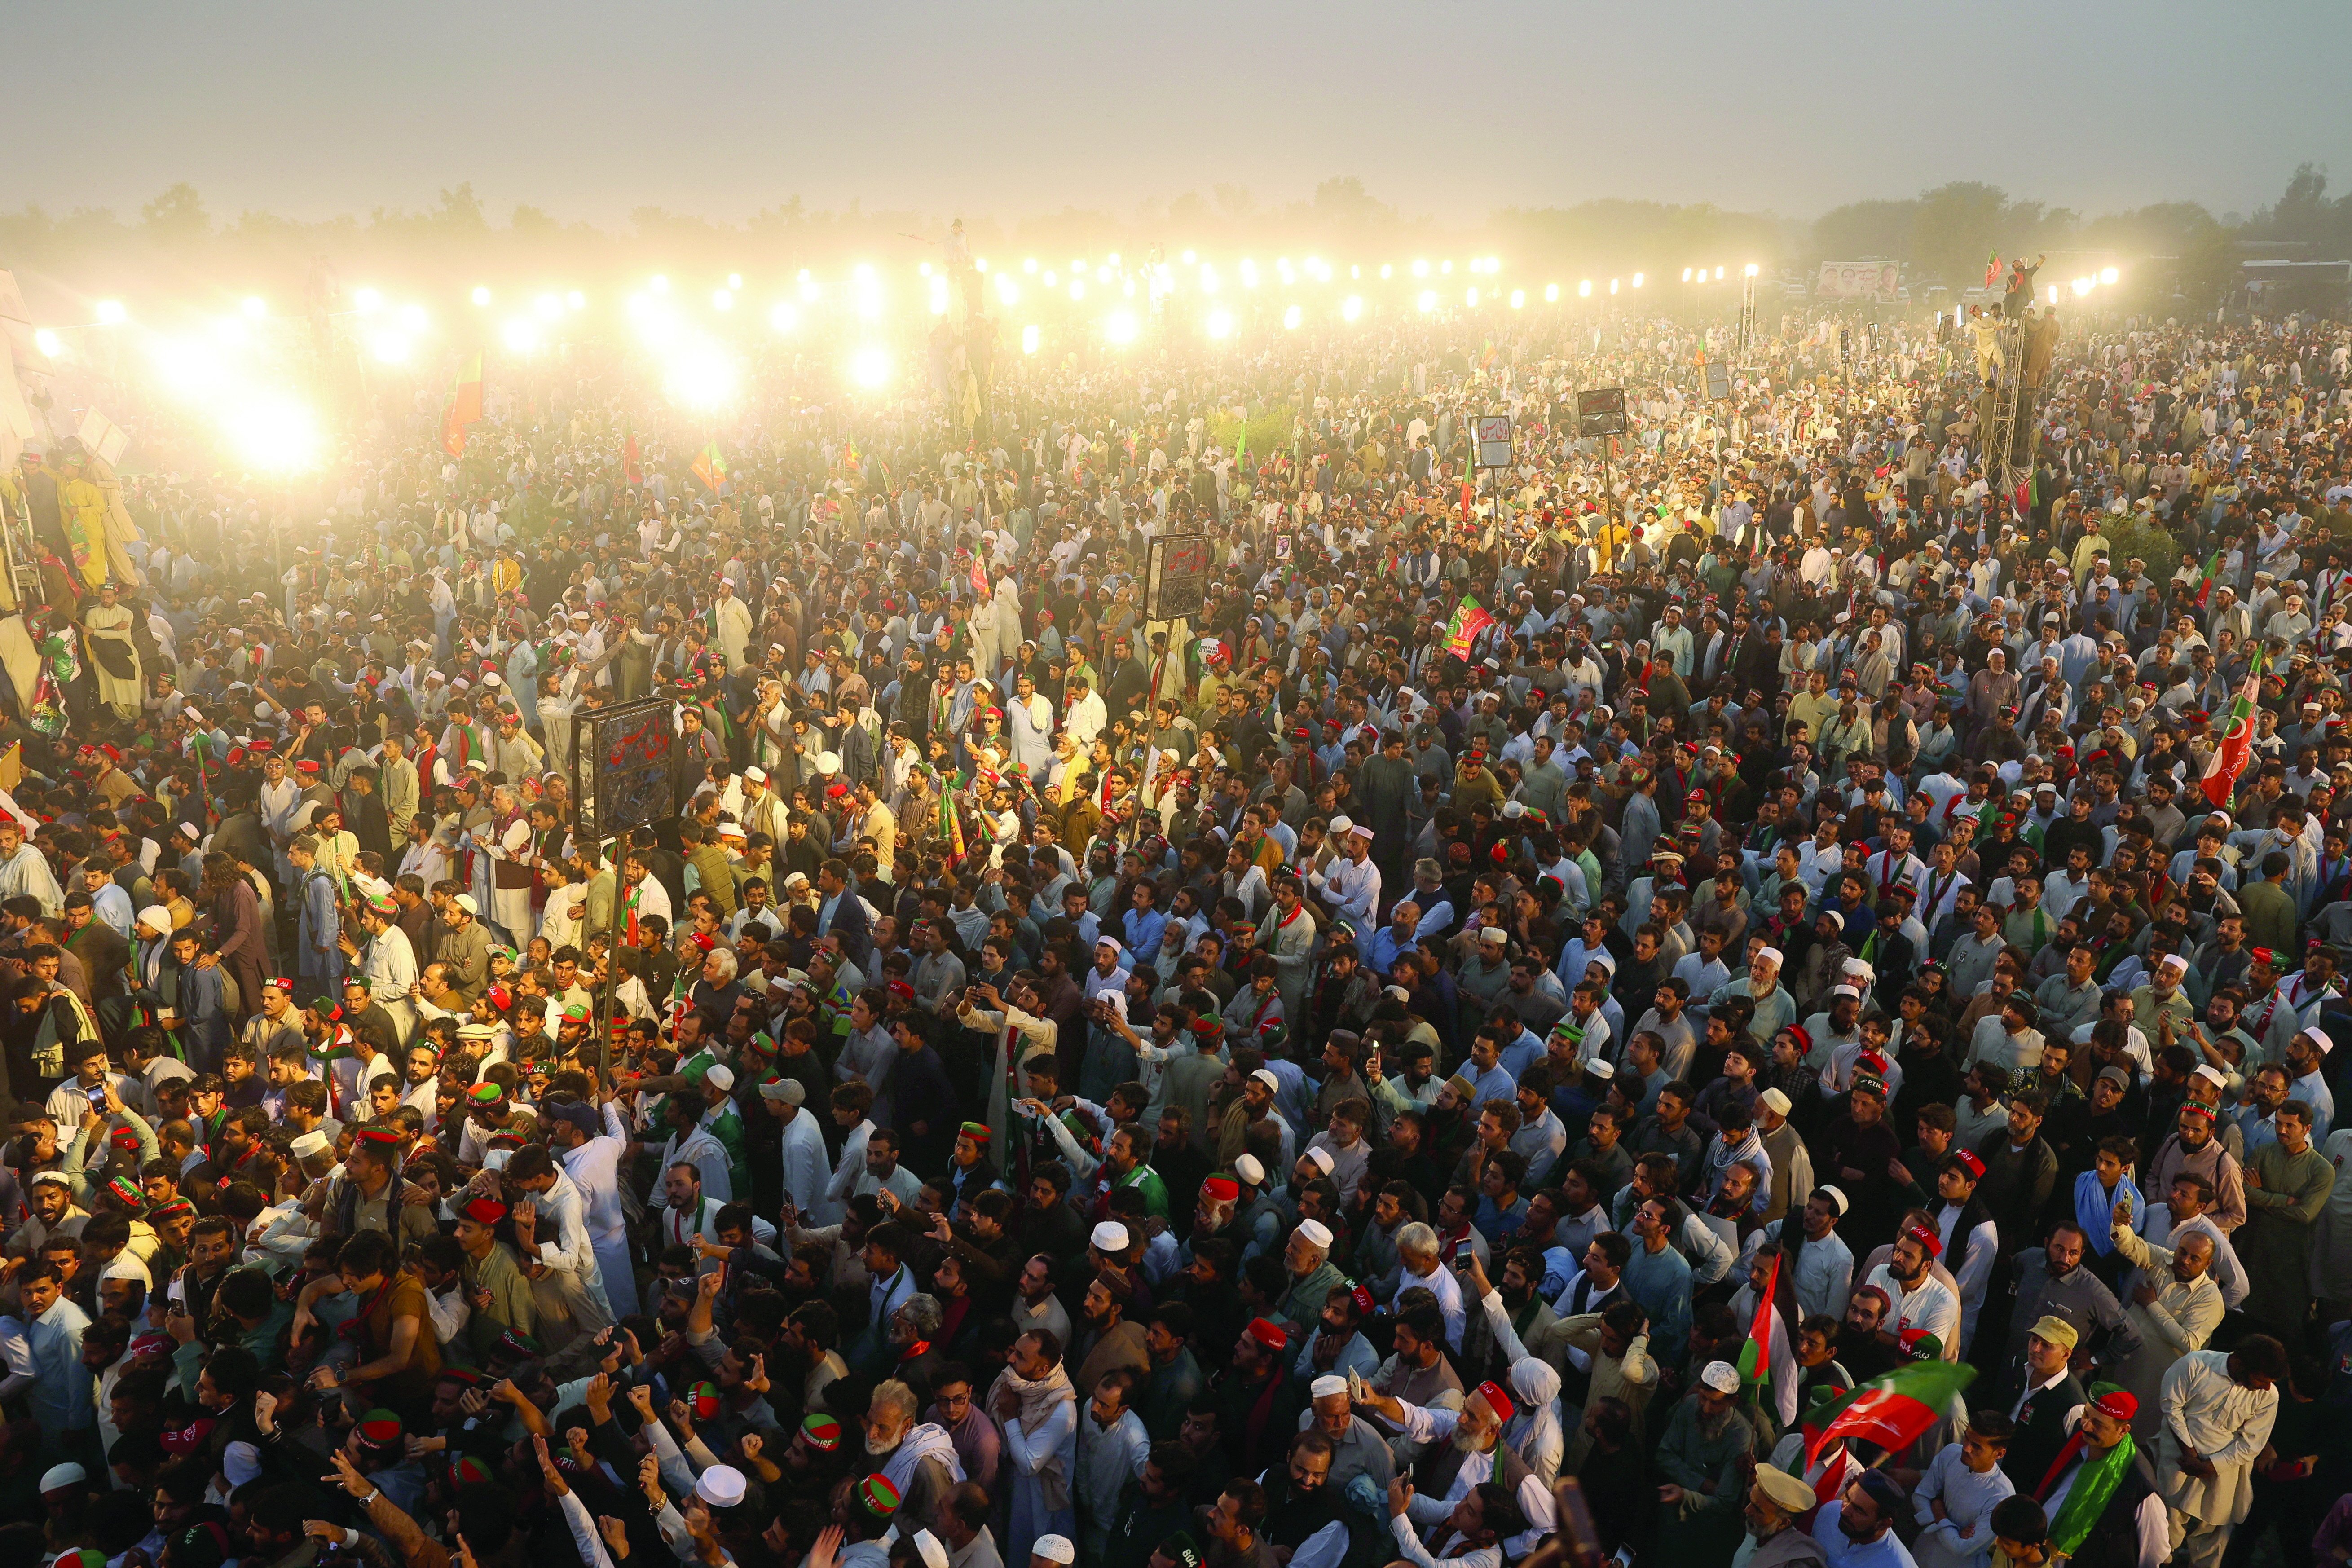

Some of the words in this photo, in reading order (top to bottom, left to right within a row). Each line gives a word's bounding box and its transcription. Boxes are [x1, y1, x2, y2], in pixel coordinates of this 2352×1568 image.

[1345, 1279, 1358, 1291] 804
[1899, 1342, 1910, 1352] 804
[168, 1432, 177, 1440] PTI
[819, 1440, 832, 1449] ISF
[1182, 1549, 1198, 1568] 804
